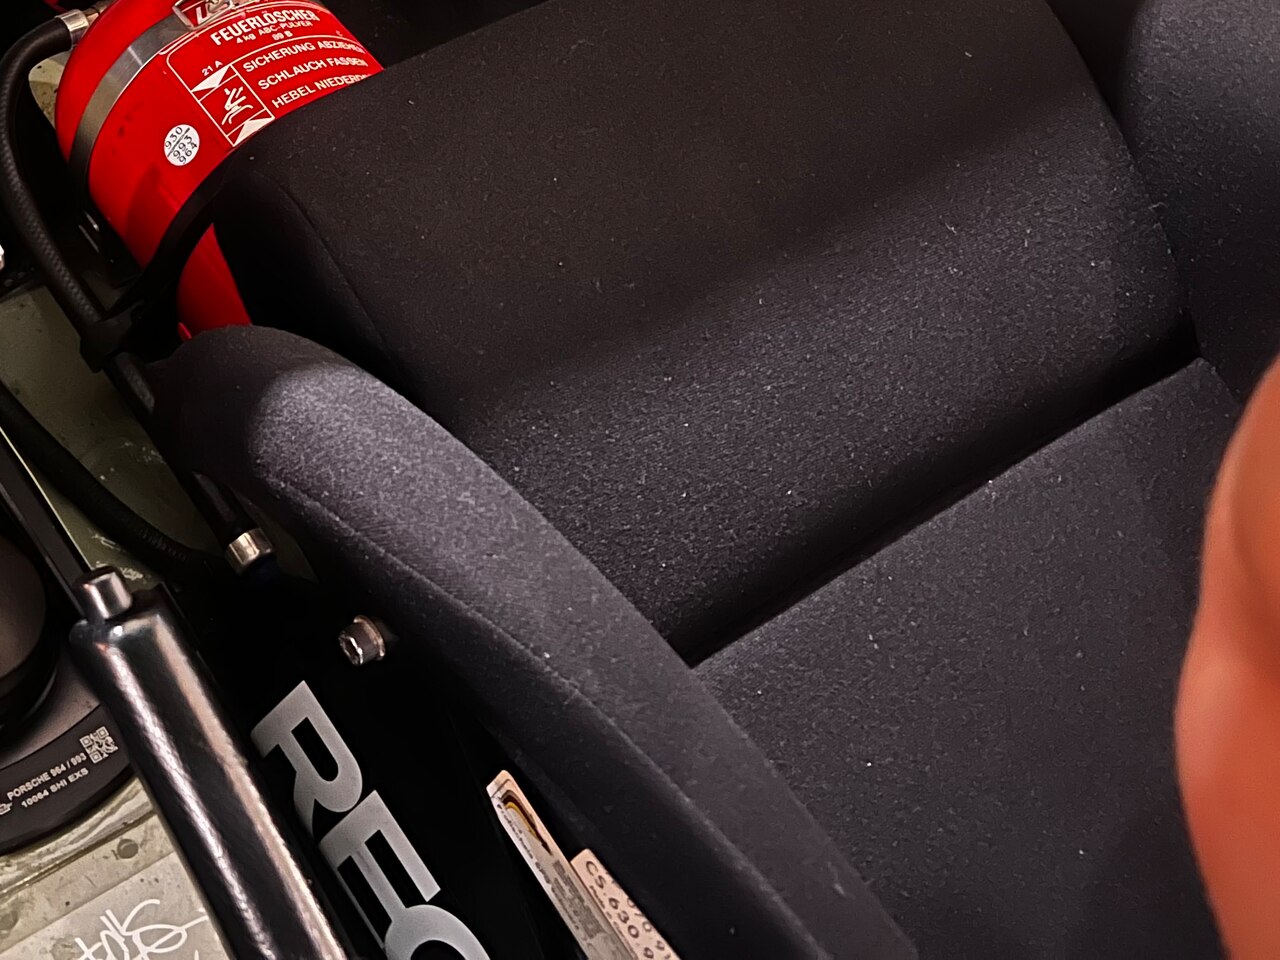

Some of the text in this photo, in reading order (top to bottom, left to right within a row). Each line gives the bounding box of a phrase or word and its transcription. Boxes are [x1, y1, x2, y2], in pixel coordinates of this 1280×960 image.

[210, 8, 321, 46] FEUERLÖSCHER
[243, 42, 316, 73] SICHERUNG
[258, 60, 326, 90] SCHLAUCH
[272, 84, 316, 109] HEBEL
[7, 772, 51, 800] PORSCHE
